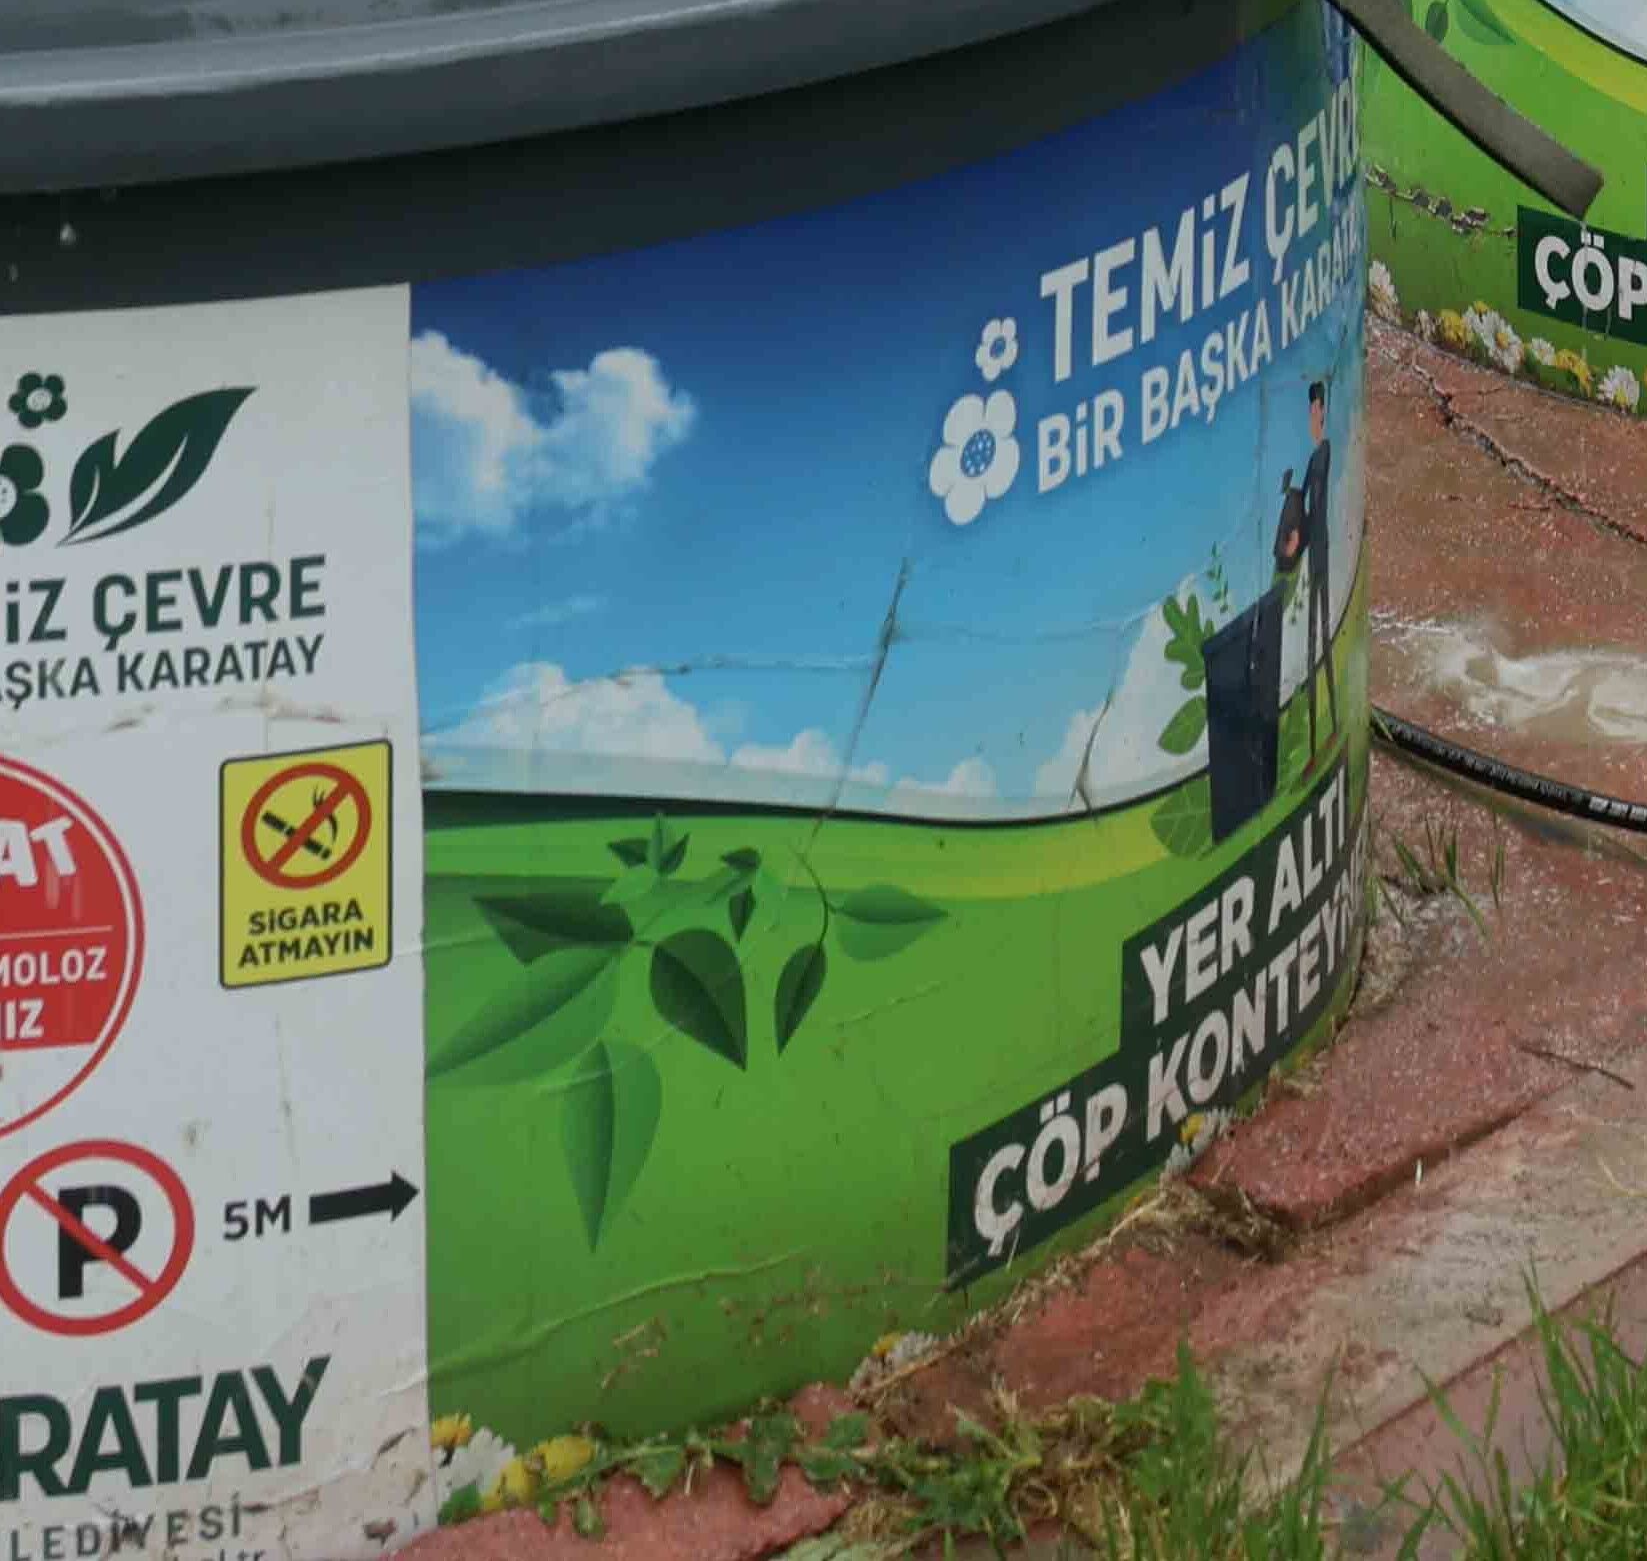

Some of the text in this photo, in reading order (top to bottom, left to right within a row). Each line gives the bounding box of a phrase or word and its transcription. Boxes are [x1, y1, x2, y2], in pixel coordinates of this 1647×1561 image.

[1140, 297, 1275, 447] BAŞKA
[92, 554, 327, 653] ÇEVRE
[116, 633, 326, 695] KARATAY
[1139, 763, 1347, 1027] YER ALTI
[238, 927, 375, 970] ATMAYIN
[222, 1194, 293, 1242] 5M
[972, 1081, 1130, 1258] ÇÖP
